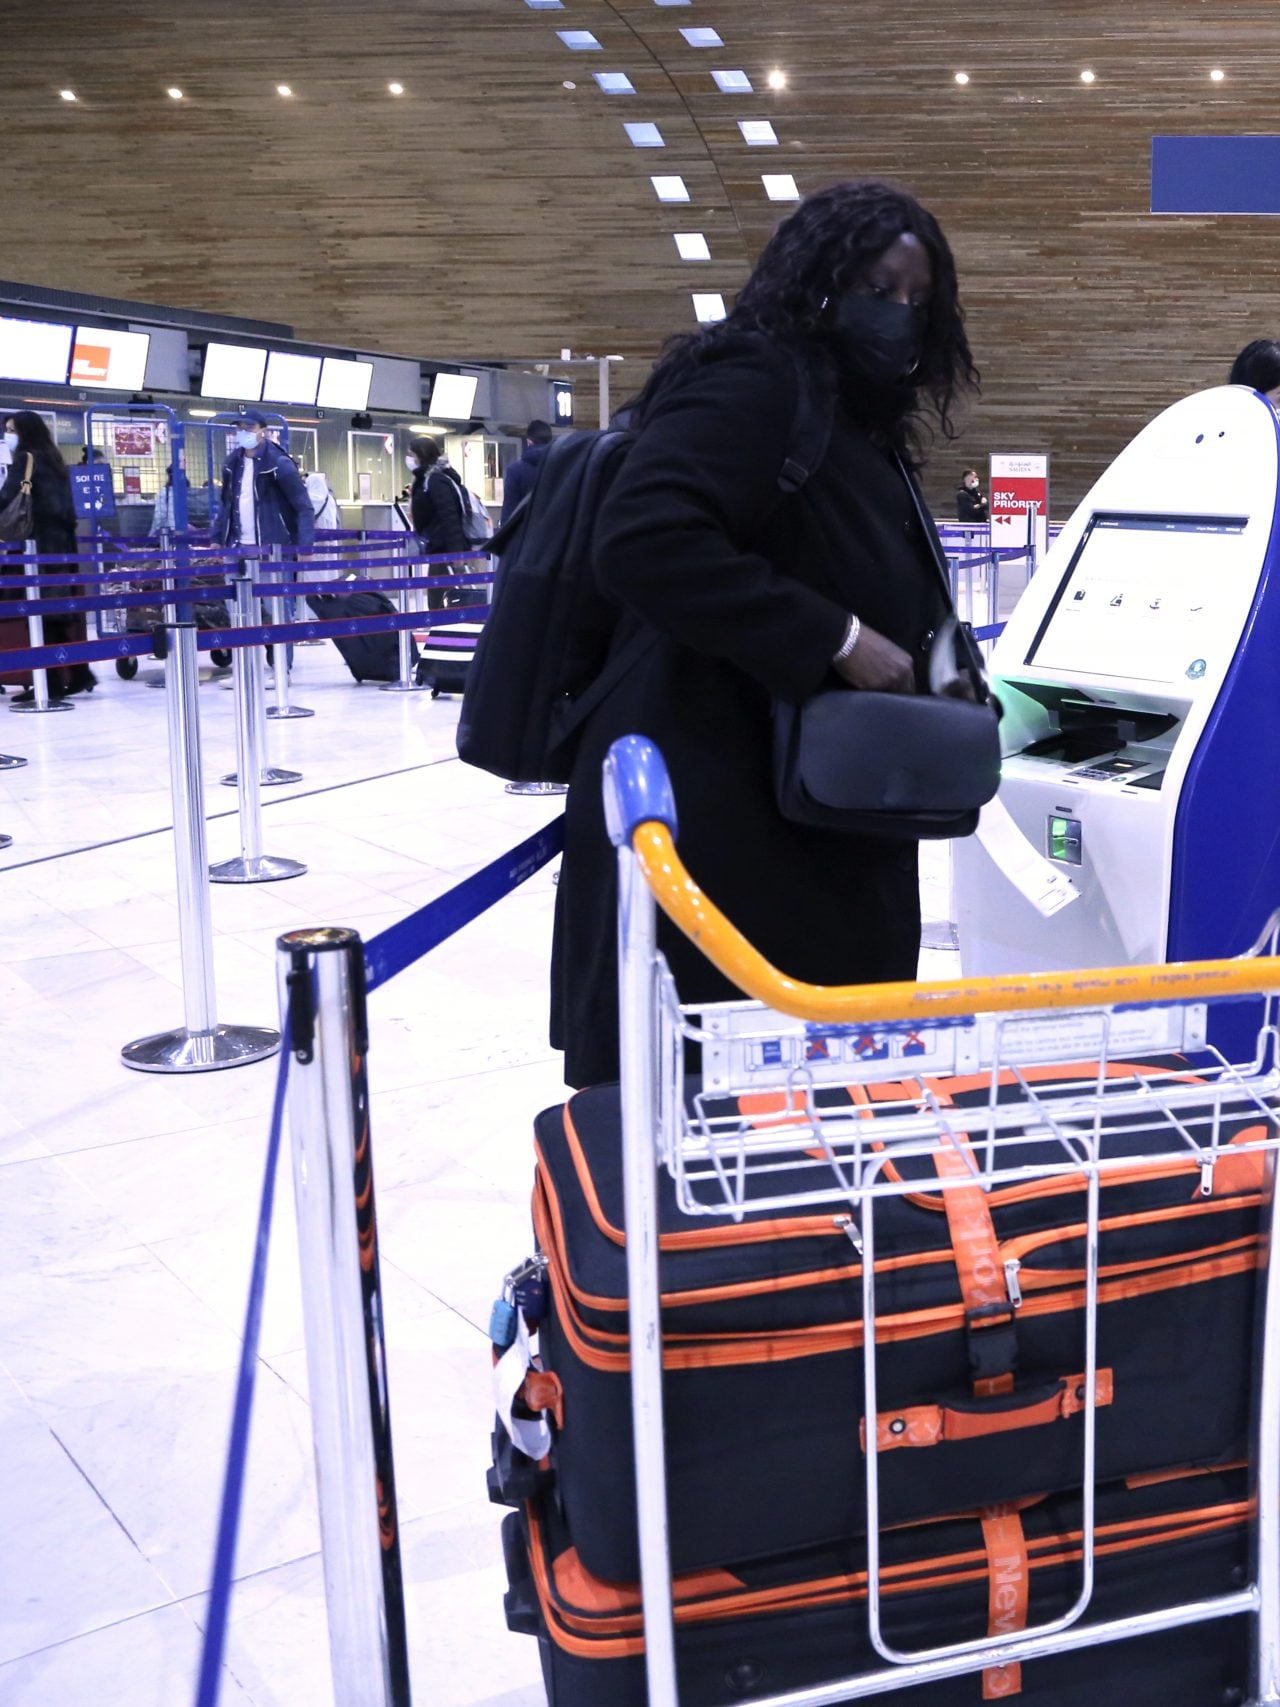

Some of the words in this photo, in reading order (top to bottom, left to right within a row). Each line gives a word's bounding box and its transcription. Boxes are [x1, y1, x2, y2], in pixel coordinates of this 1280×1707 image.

[75, 474, 105, 483] SOTIE
[993, 491, 1015, 500] SKY
[993, 500, 1043, 509] PRIORITY
